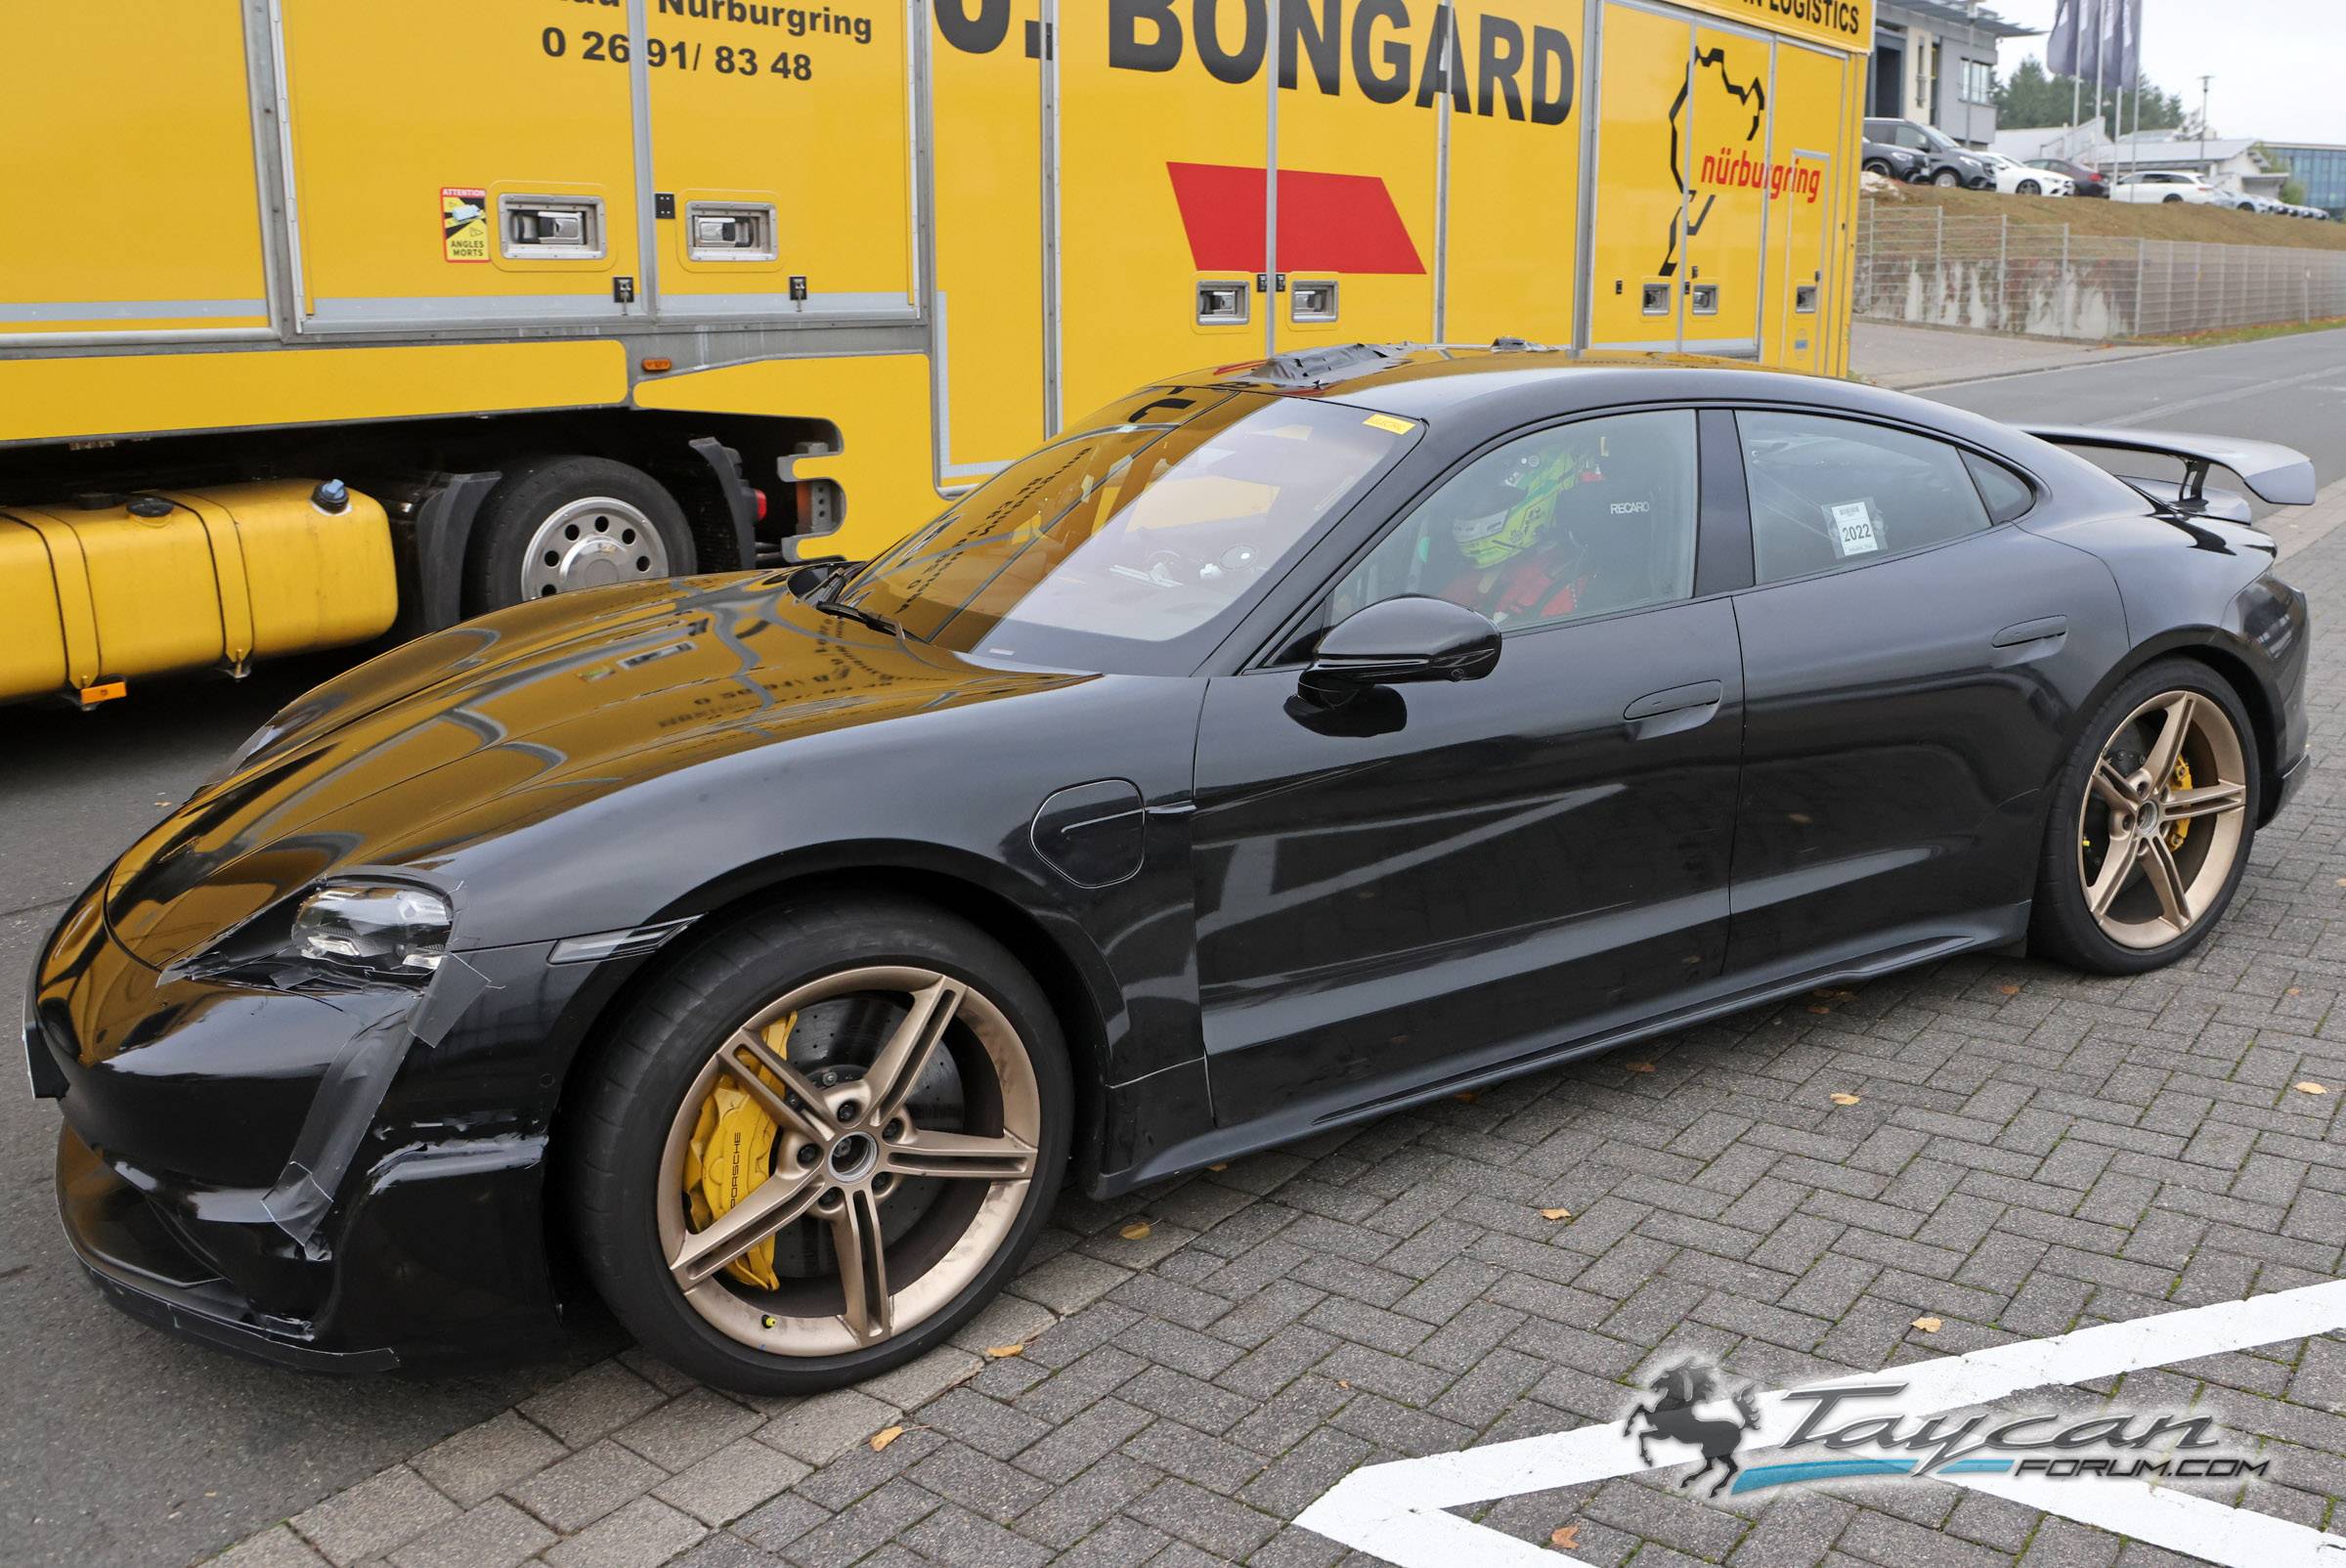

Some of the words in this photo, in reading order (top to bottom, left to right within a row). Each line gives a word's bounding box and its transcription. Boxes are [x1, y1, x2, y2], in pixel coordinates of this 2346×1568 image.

[542, 26, 566, 58] 0
[715, 45, 758, 75] 83
[770, 52, 812, 81] 48
[1108, 0, 1575, 125] BONGARD
[1701, 147, 1820, 203] nürburgring
[451, 240, 485, 248] ANGLES
[453, 248, 484, 257] MORTS
[1610, 501, 1650, 514] RECARO
[1842, 523, 1872, 543] 2022
[730, 1132, 741, 1209] PORSCHE
